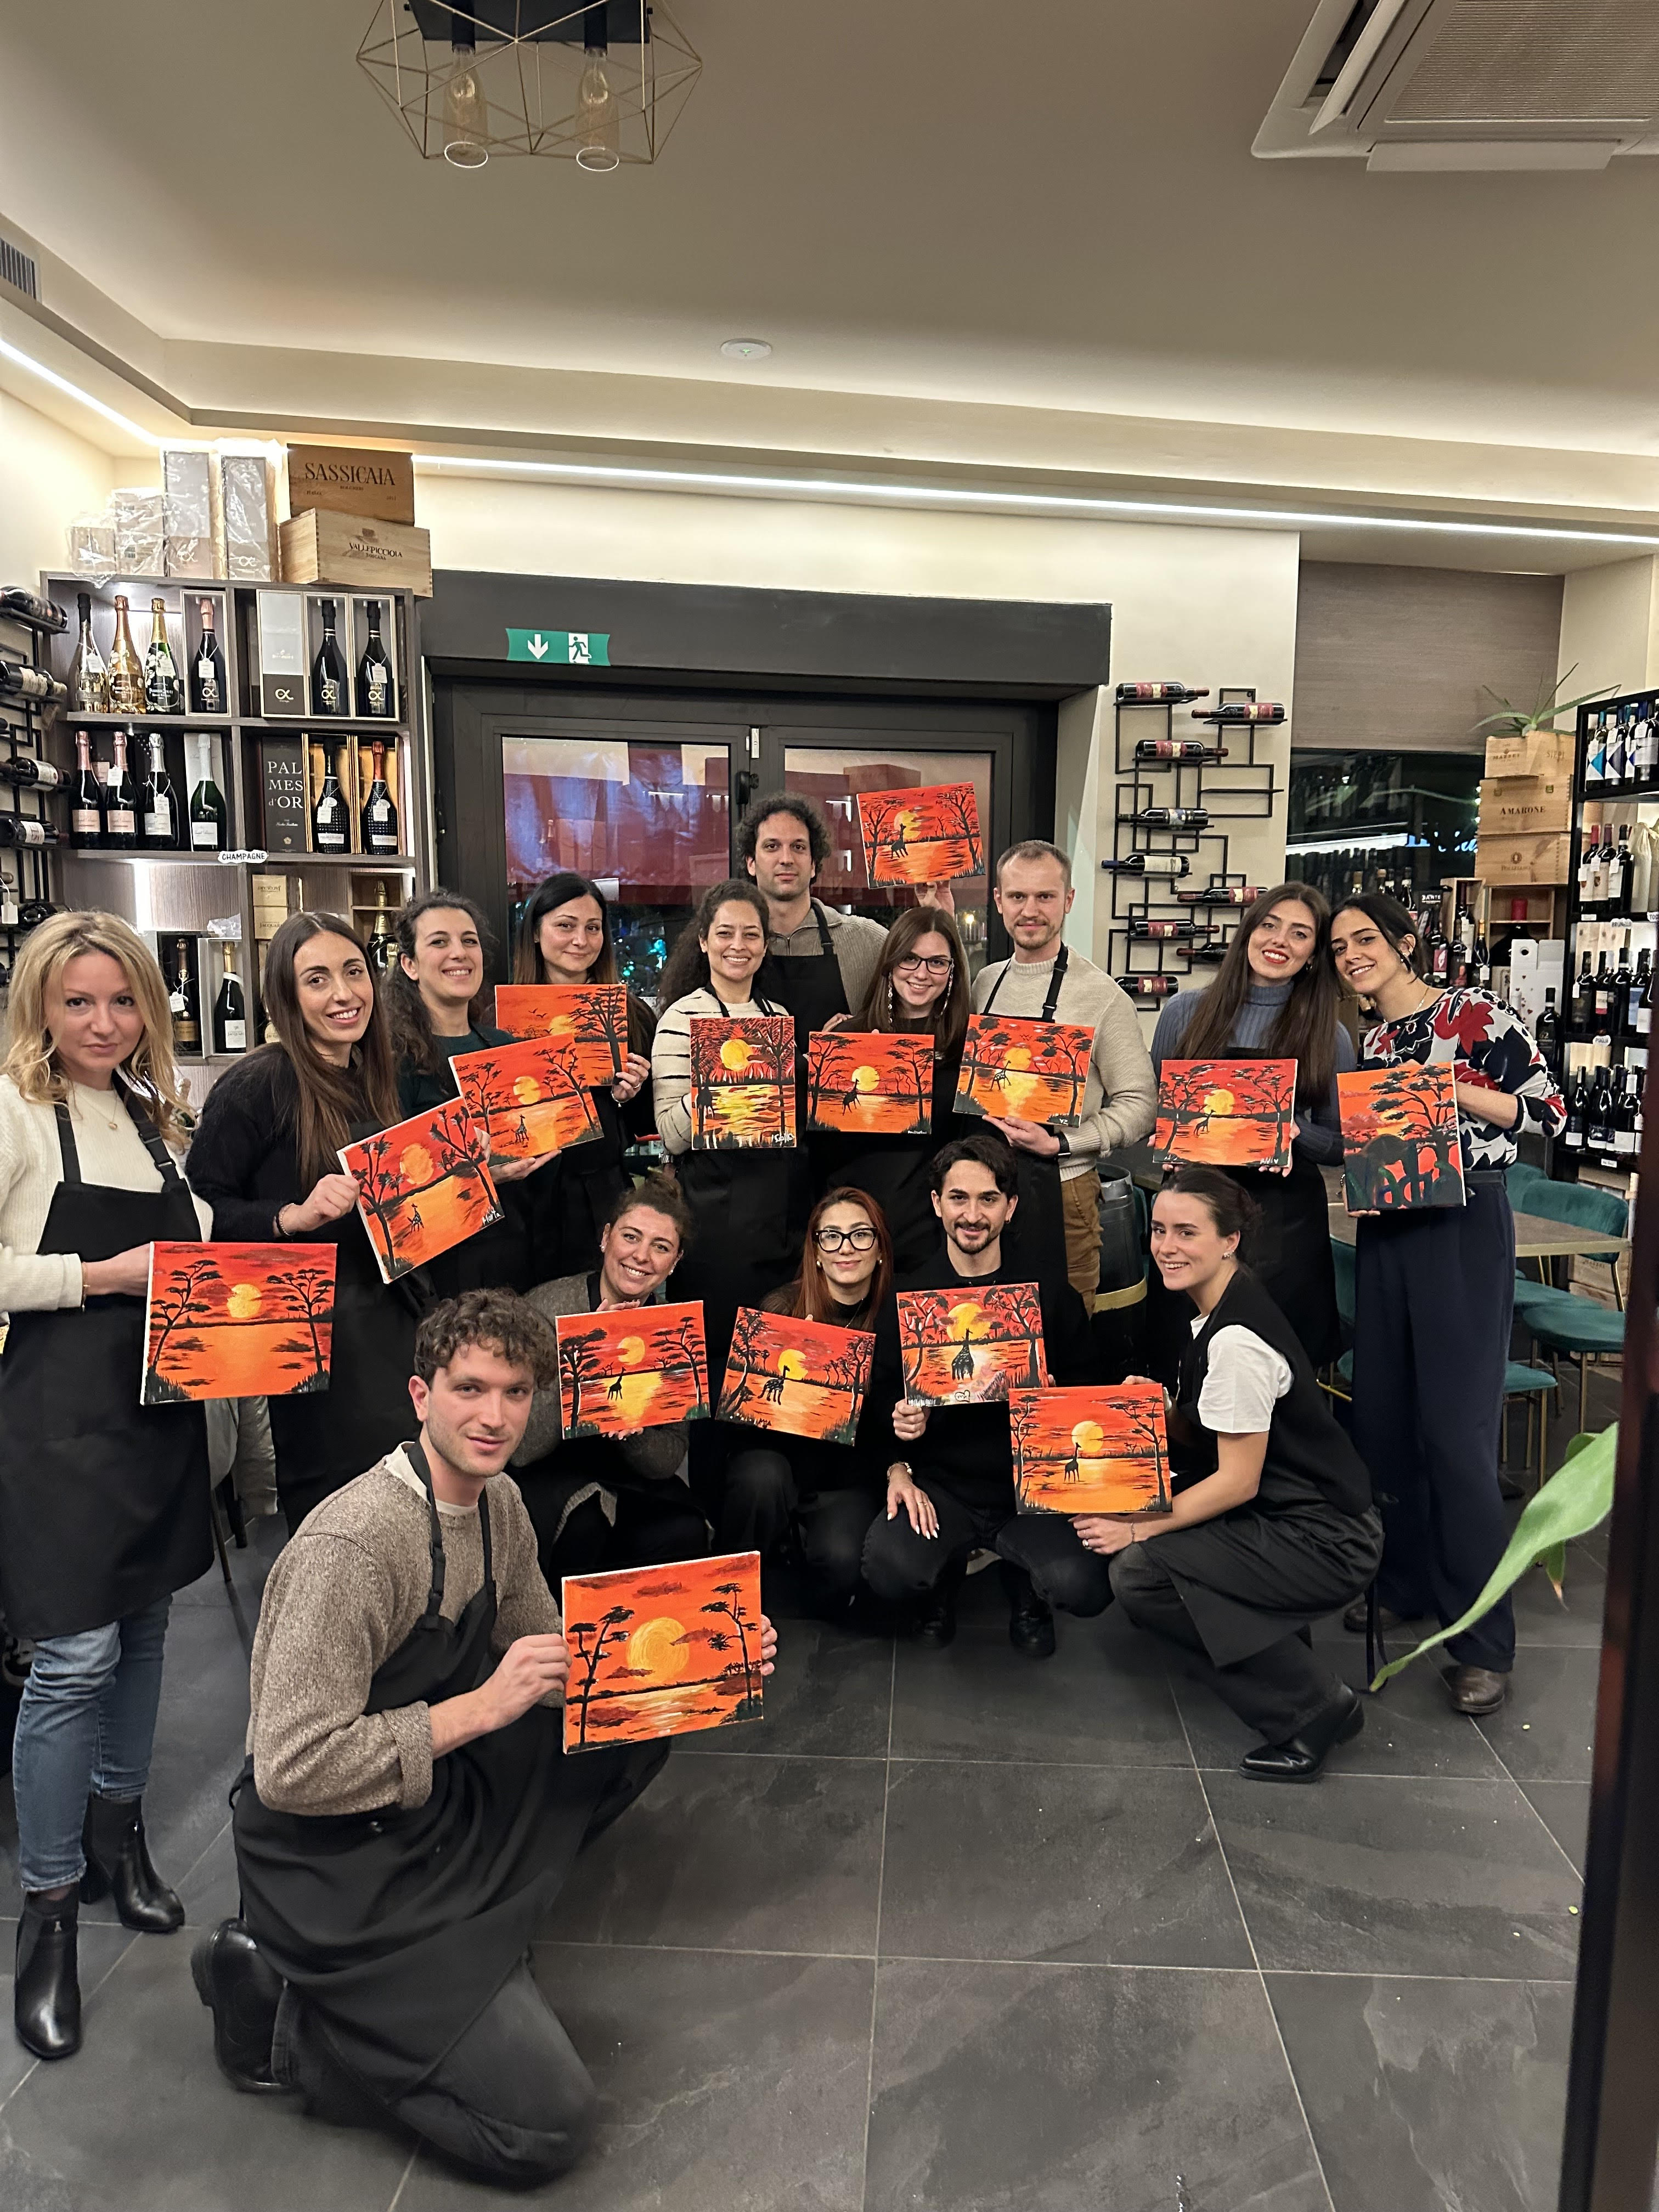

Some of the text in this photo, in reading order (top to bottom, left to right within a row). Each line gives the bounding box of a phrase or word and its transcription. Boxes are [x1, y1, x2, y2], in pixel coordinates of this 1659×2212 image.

[305, 462, 396, 486] SASSICAIA
[349, 543, 403, 557] VALLEPICCIOLA
[268, 761, 302, 774] PAL
[269, 780, 303, 791] MES
[268, 796, 303, 809] d'OR
[1500, 806, 1545, 815] AMARONE
[482, 1208, 501, 1226] Marta
